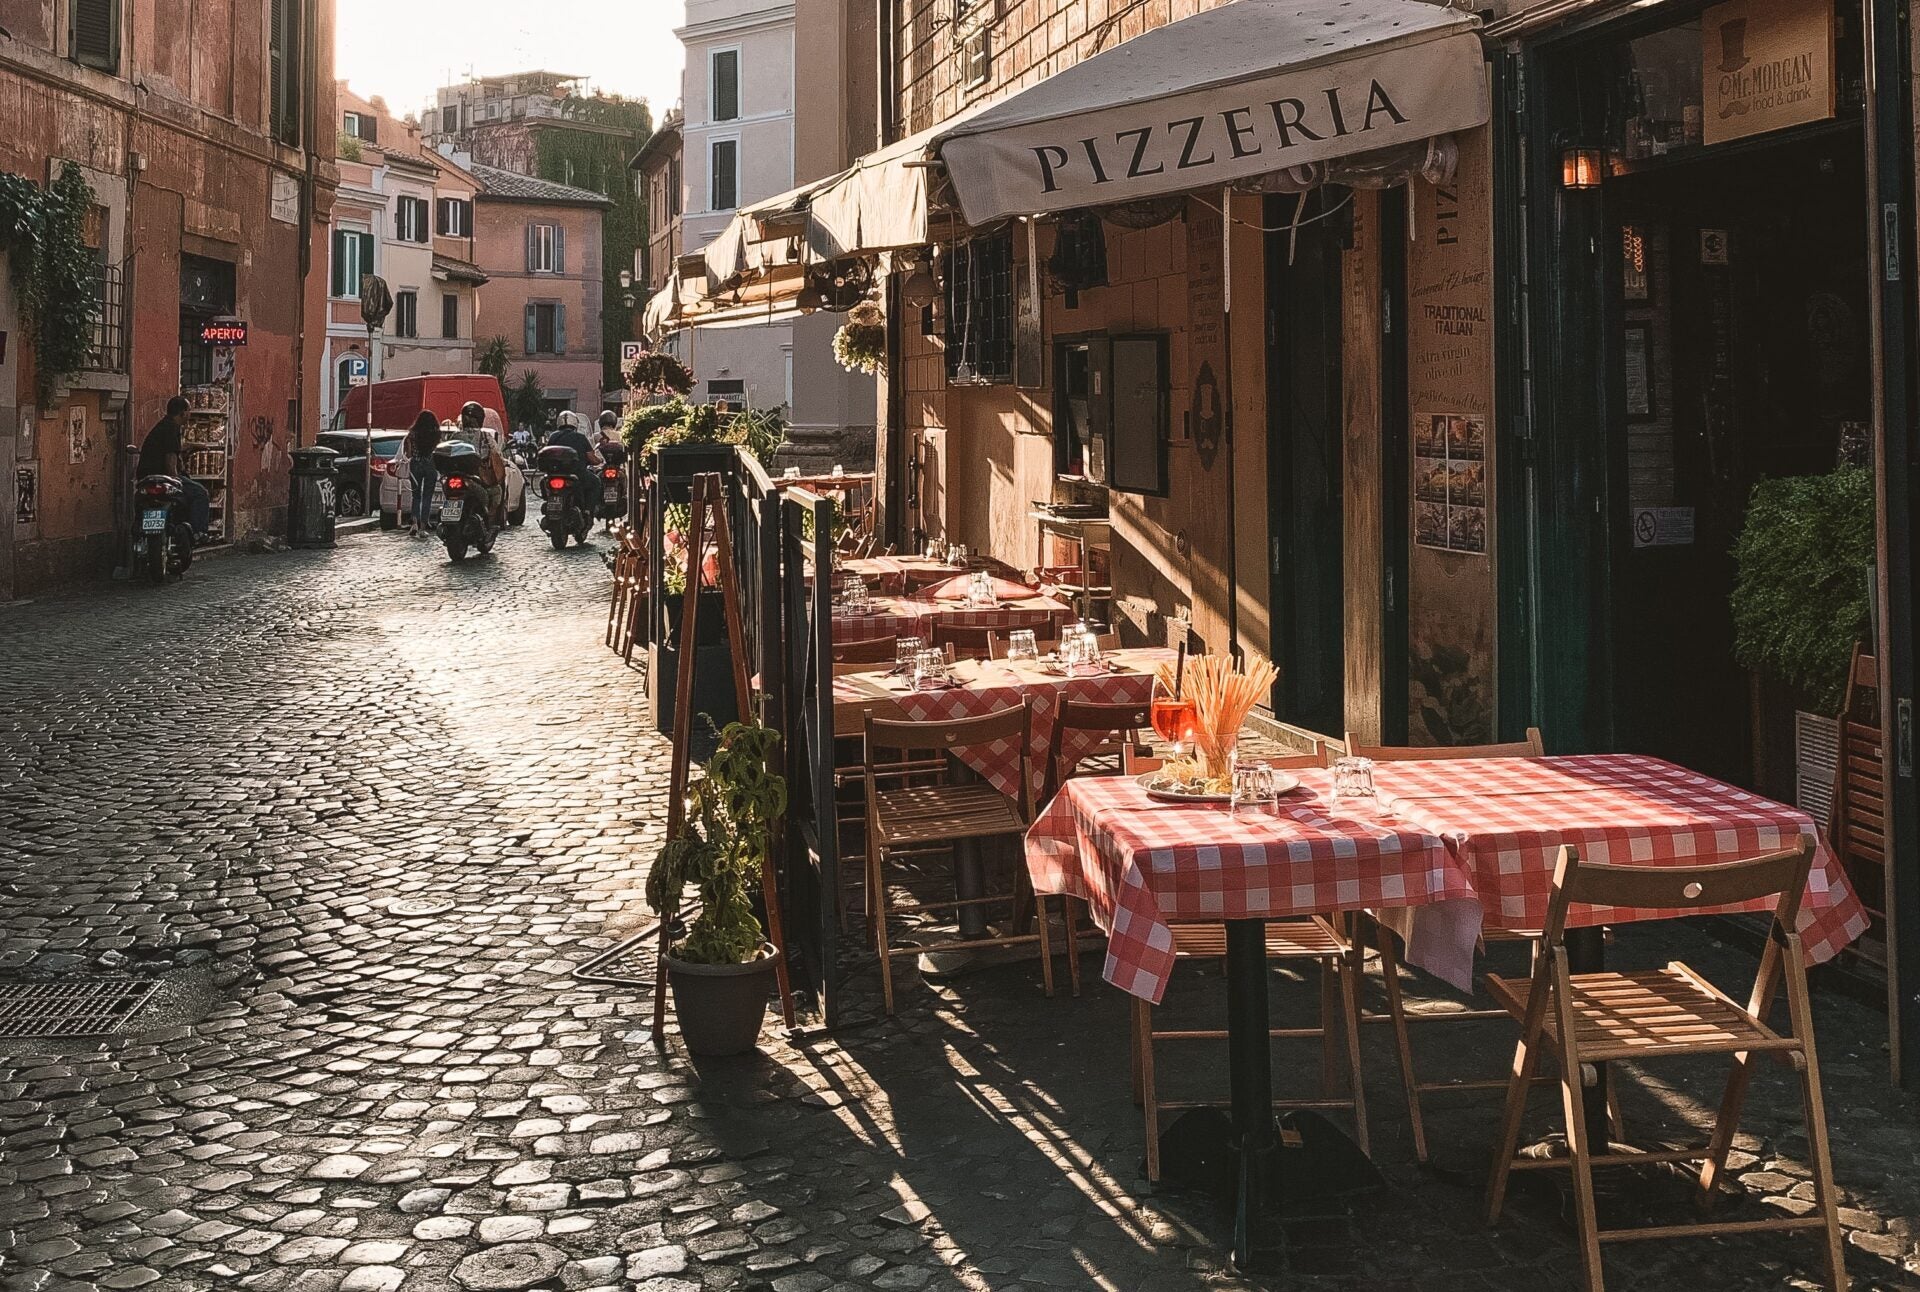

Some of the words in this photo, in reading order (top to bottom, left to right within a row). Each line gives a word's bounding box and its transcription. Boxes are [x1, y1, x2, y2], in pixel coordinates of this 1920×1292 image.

[1753, 93, 1774, 111] food
[1777, 91, 1784, 105] &
[1787, 84, 1812, 103] drink
[1029, 78, 1410, 194] PIZZERIA
[1436, 166, 1459, 246] PIZ
[1424, 304, 1486, 322] TRADITIONAL
[203, 328, 244, 340] APERTO
[1435, 320, 1473, 336] ITALIAN
[353, 360, 365, 375] P
